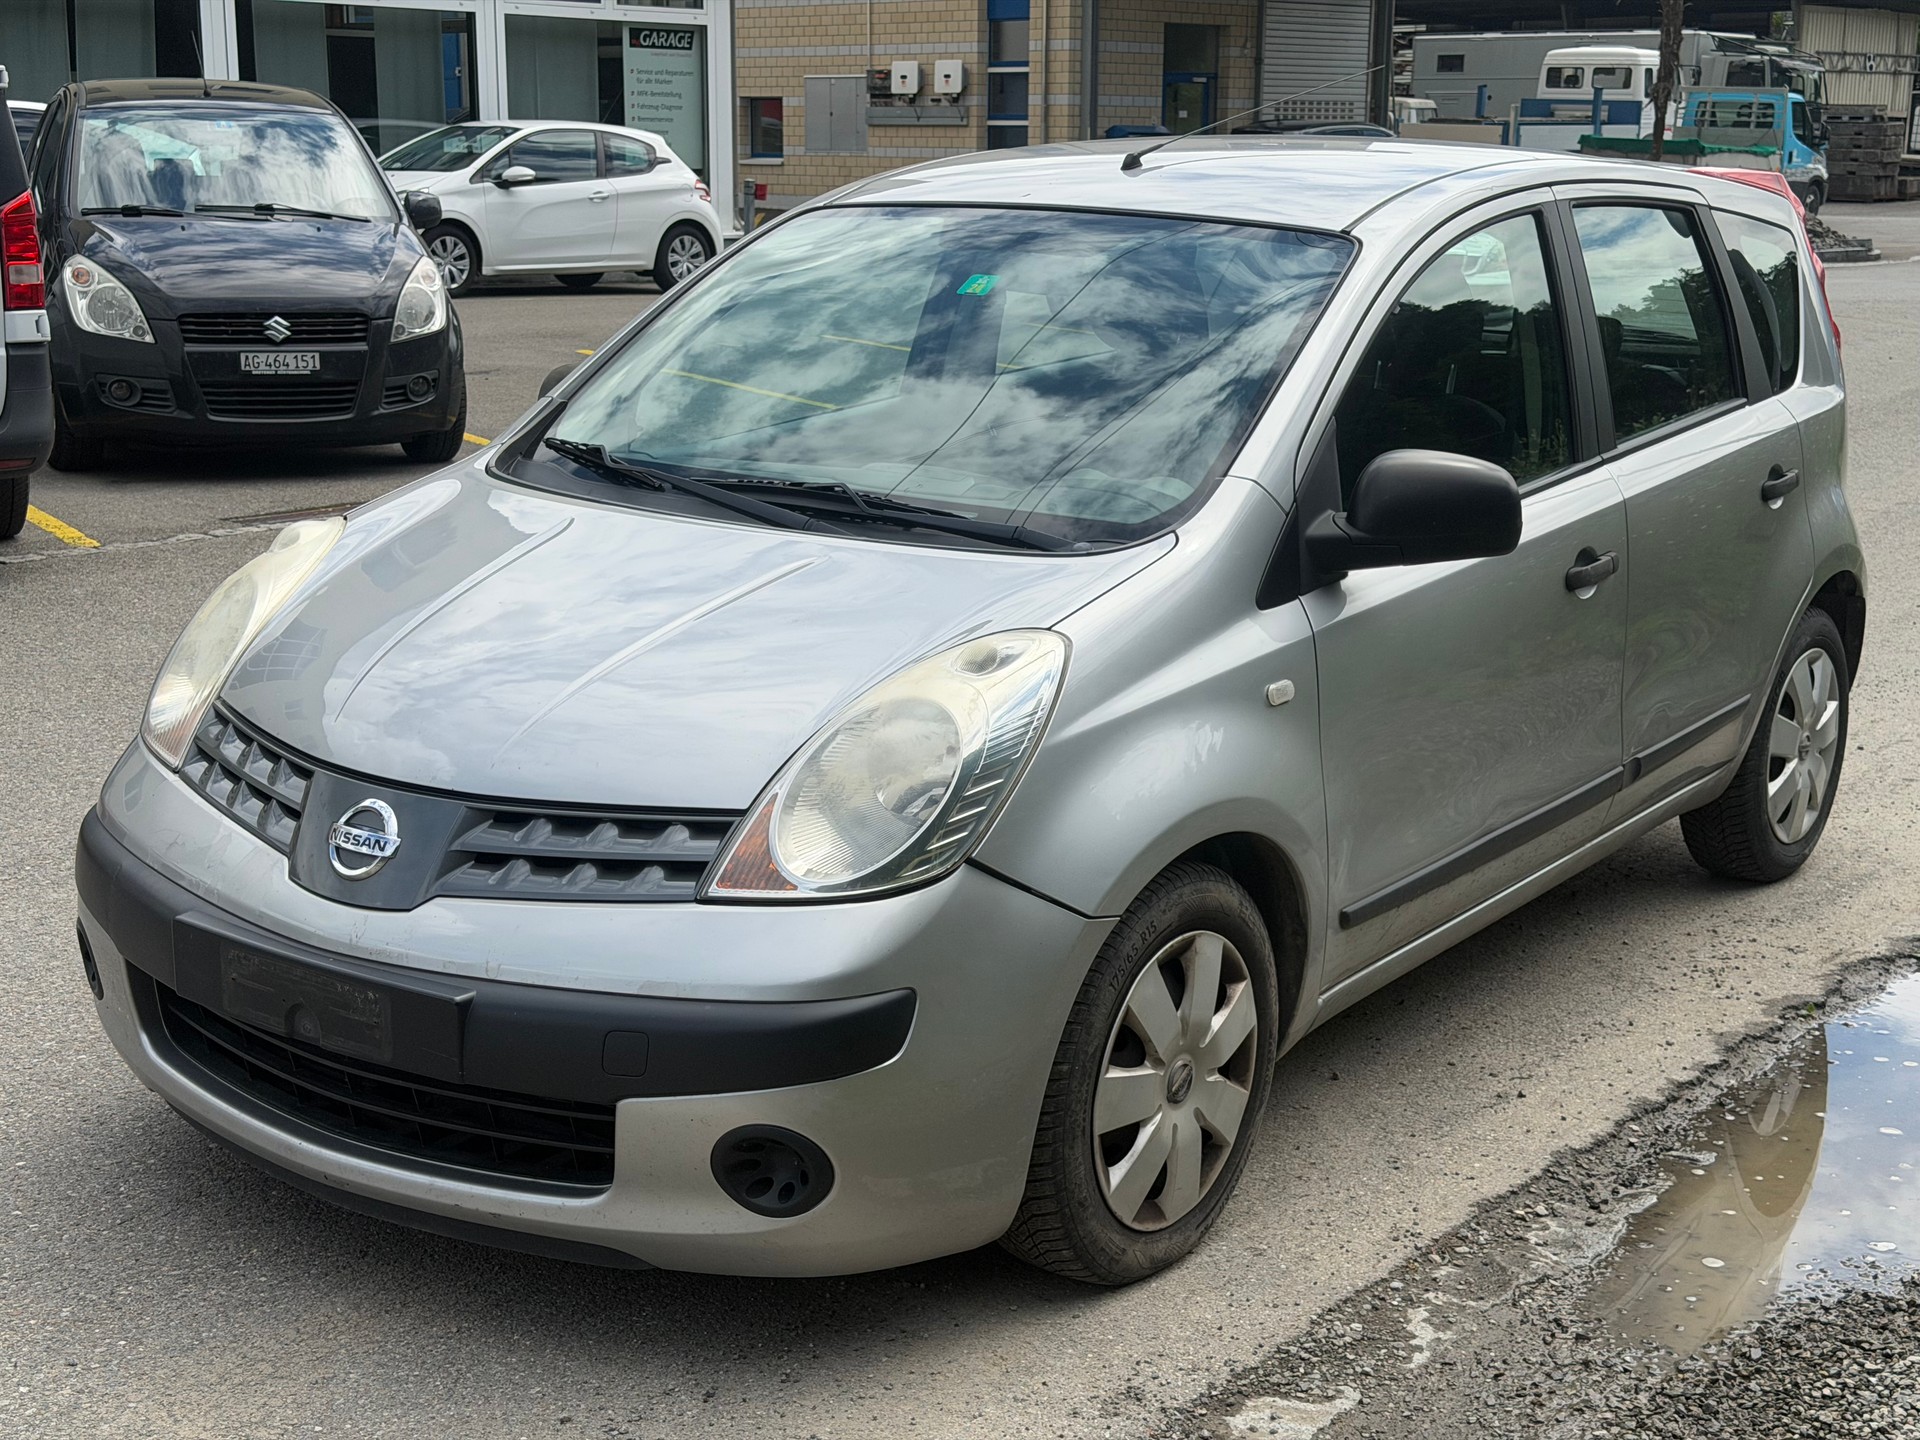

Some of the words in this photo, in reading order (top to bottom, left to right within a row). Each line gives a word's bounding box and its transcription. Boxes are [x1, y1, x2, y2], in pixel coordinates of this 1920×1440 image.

[640, 30, 692, 48] GARAGE
[330, 826, 388, 853] NISSAN
[1109, 943, 1140, 993] 175/65
[1140, 920, 1158, 945] R15
